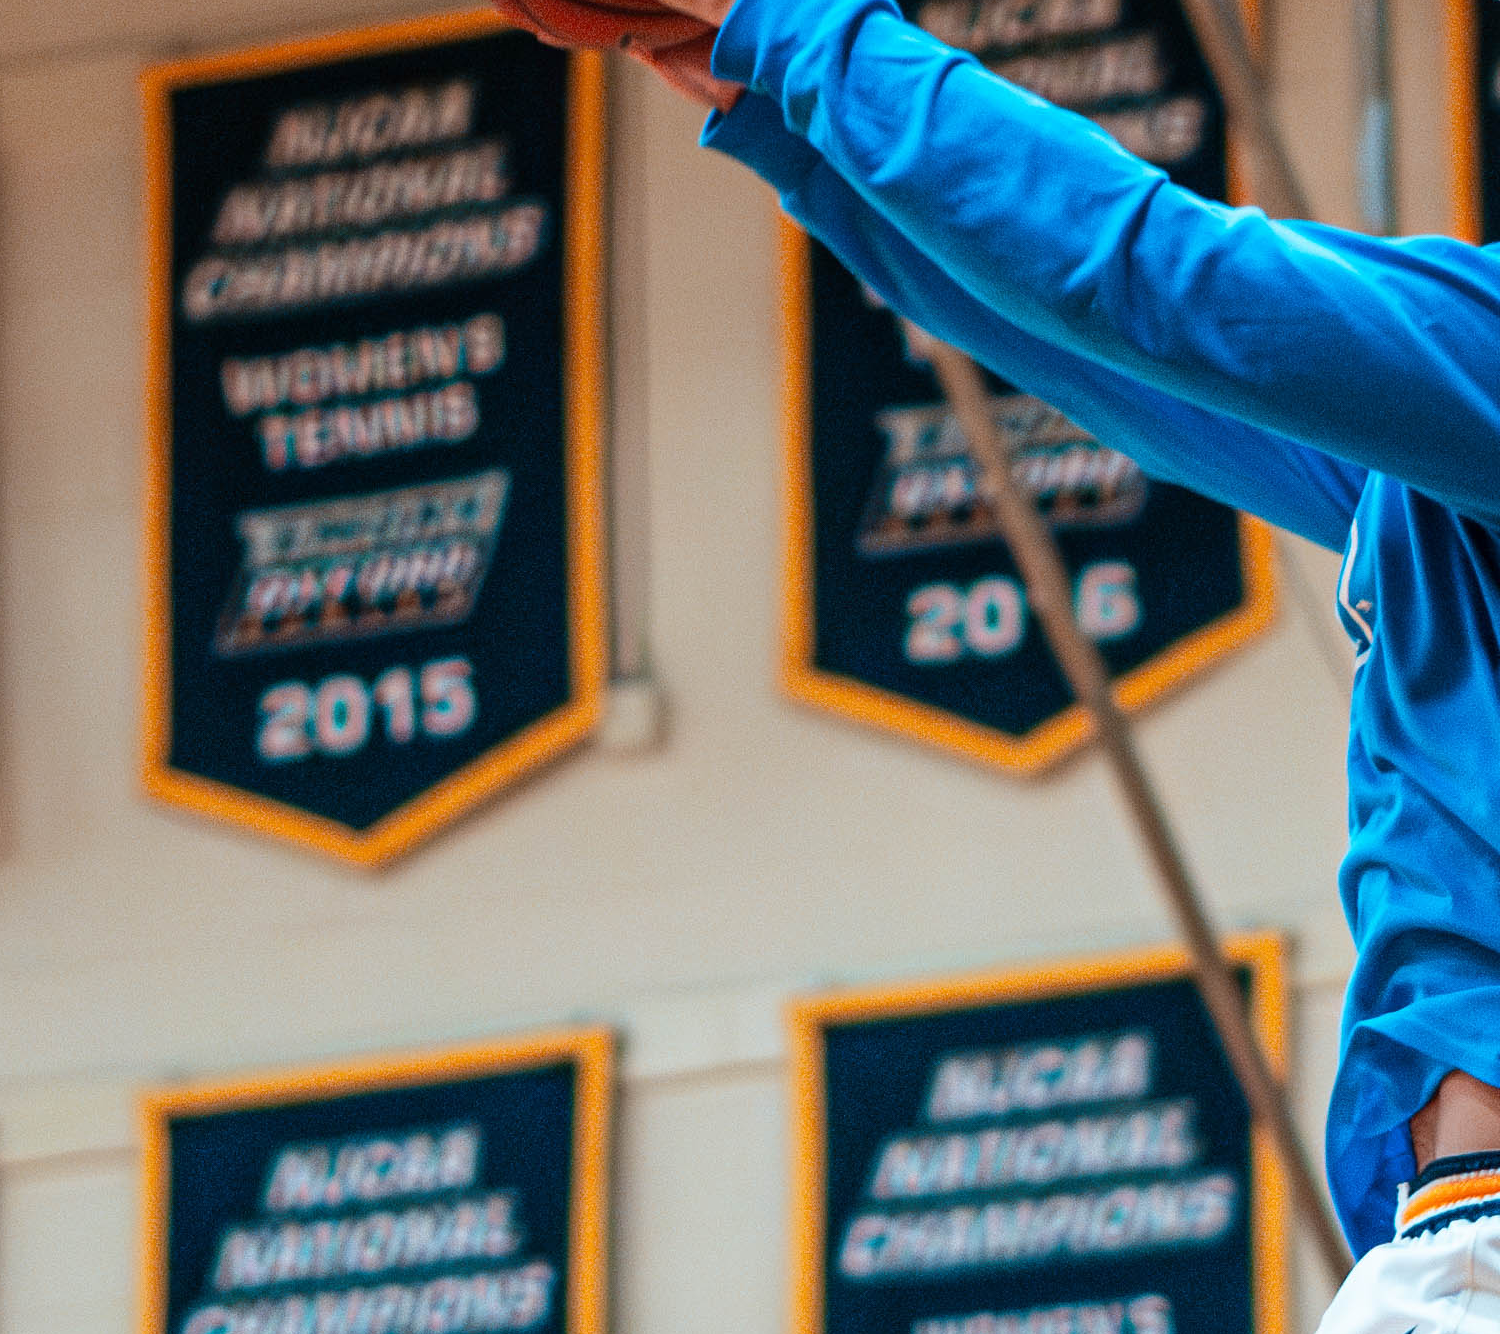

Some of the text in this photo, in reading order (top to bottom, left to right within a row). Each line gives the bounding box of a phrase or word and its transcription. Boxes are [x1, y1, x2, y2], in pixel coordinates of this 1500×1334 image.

[189, 204, 541, 319] CHAMPIONS
[227, 320, 499, 412] WOMEN'S
[266, 387, 474, 465] TENNIS
[910, 566, 1136, 657] 206
[262, 663, 472, 759] 2015
[878, 1102, 1193, 1194] NATIONAL
[220, 1197, 512, 1287] NATIONAL
[846, 1179, 1231, 1273] CHAMPIONS
